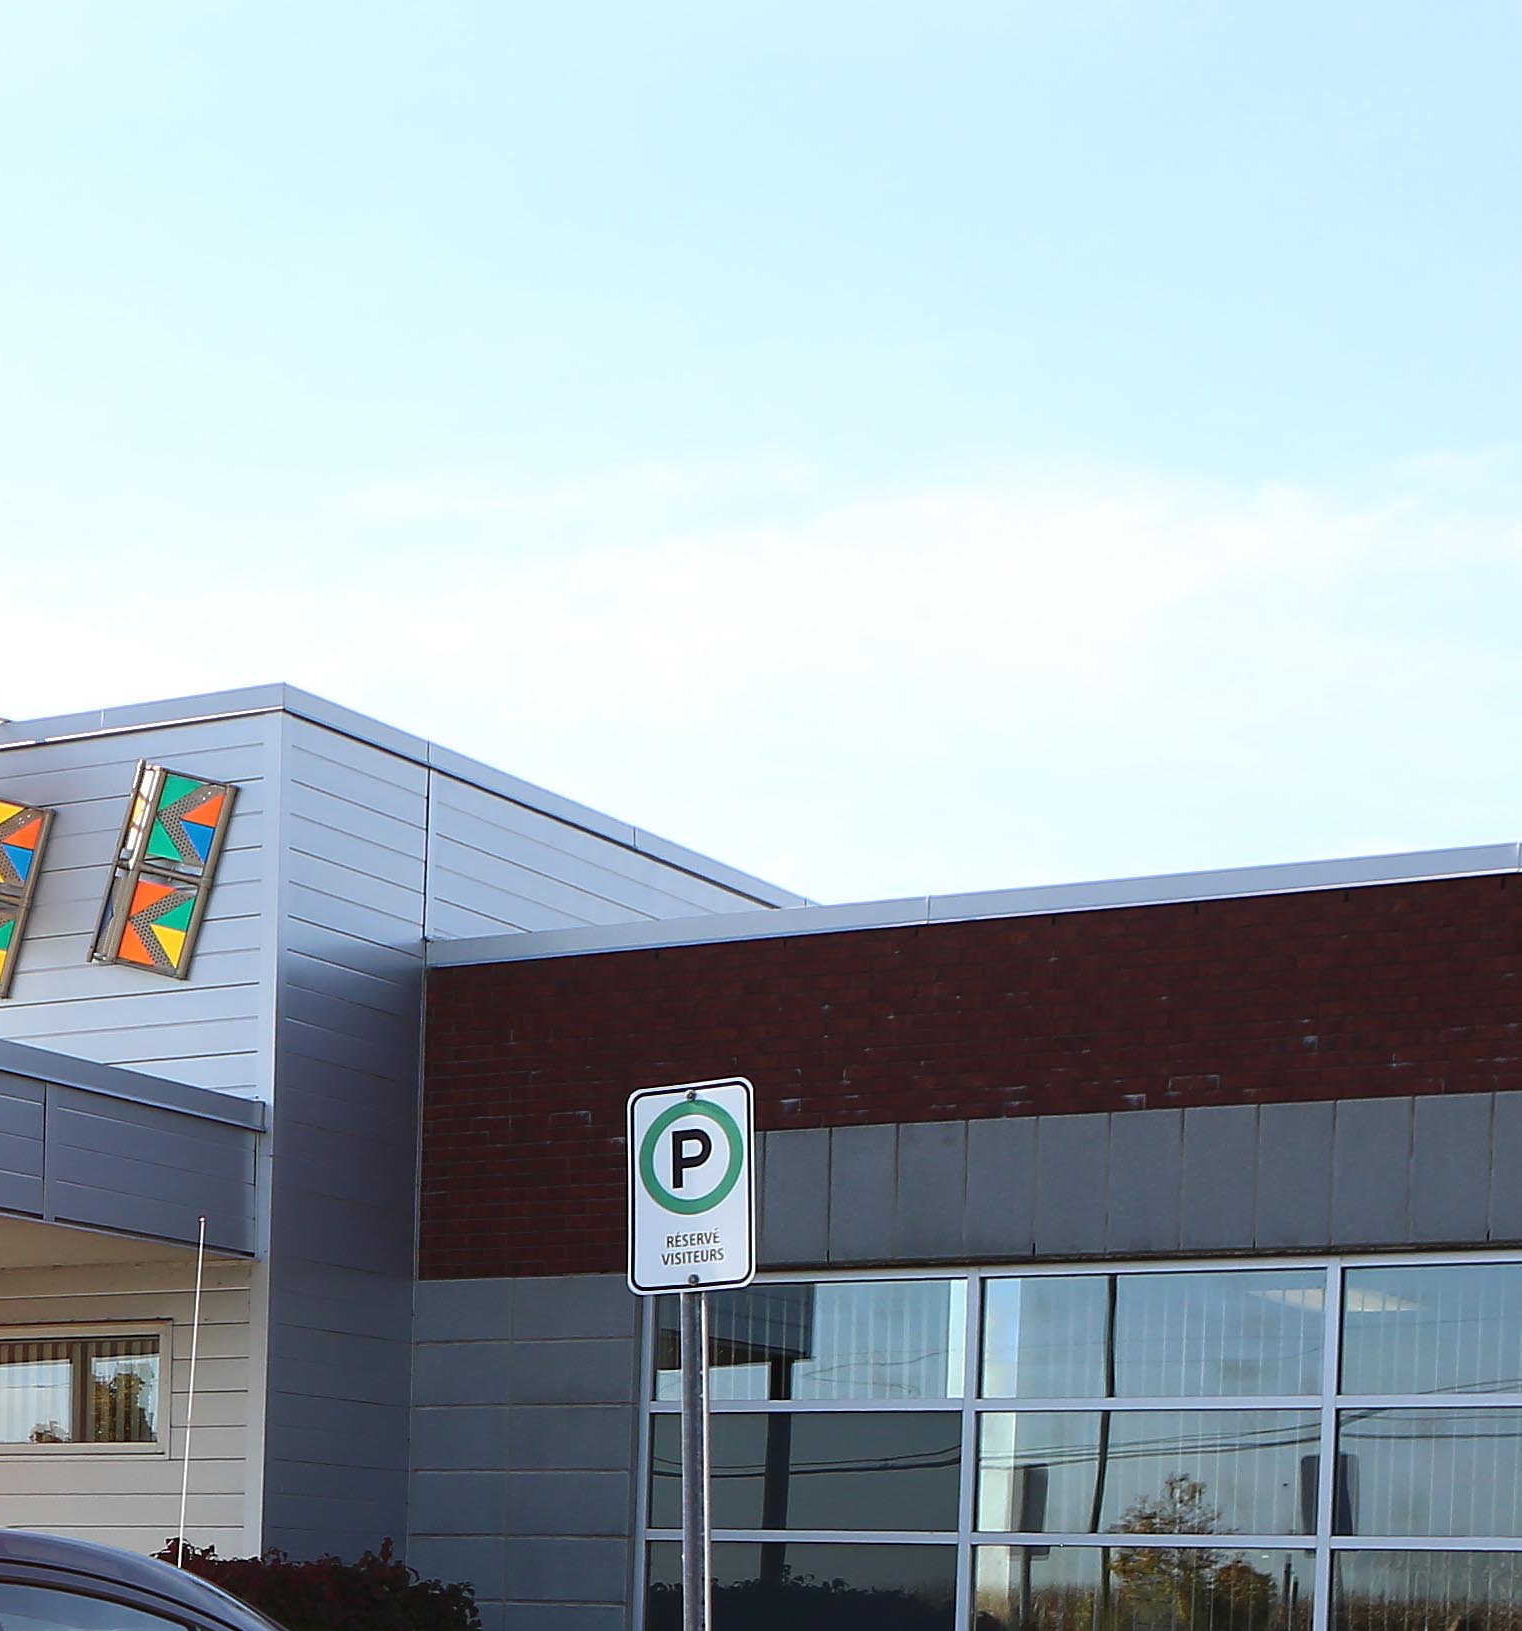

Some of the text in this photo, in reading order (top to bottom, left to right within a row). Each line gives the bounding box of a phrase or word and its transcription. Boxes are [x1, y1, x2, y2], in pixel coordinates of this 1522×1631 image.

[672, 1128, 712, 1189] P
[666, 1227, 720, 1248] RÉSERVÉ
[661, 1247, 725, 1266] VISITEURS
